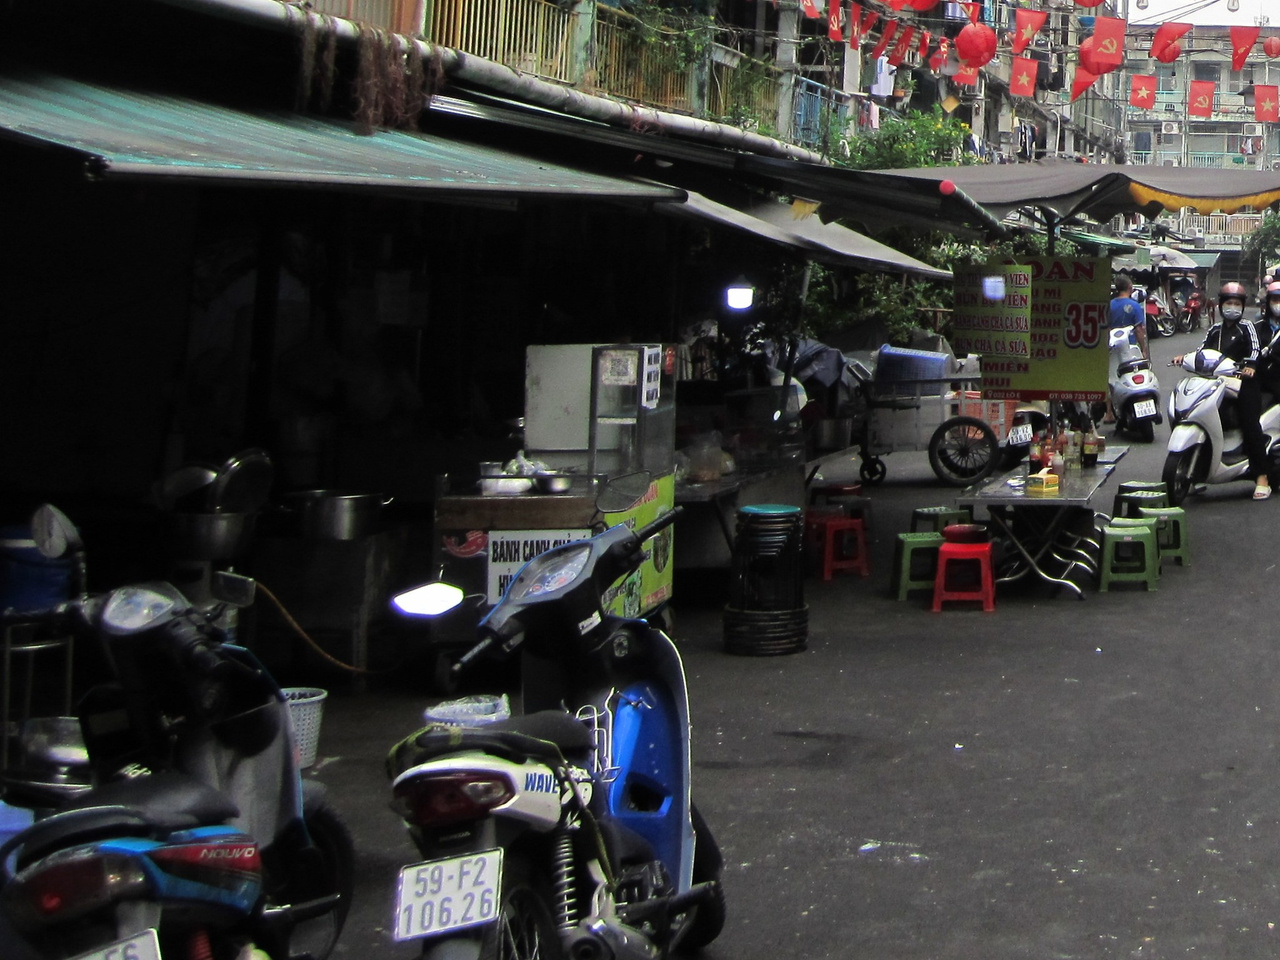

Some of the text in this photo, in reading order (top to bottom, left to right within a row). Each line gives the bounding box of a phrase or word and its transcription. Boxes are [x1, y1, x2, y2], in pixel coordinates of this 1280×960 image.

[1003, 260, 1096, 281] OAN
[492, 536, 520, 562] BÁNH
[525, 772, 559, 793] WAVE
[200, 846, 255, 859] NOUVO
[414, 856, 488, 898] 59-F2
[402, 887, 494, 936] 106.26
